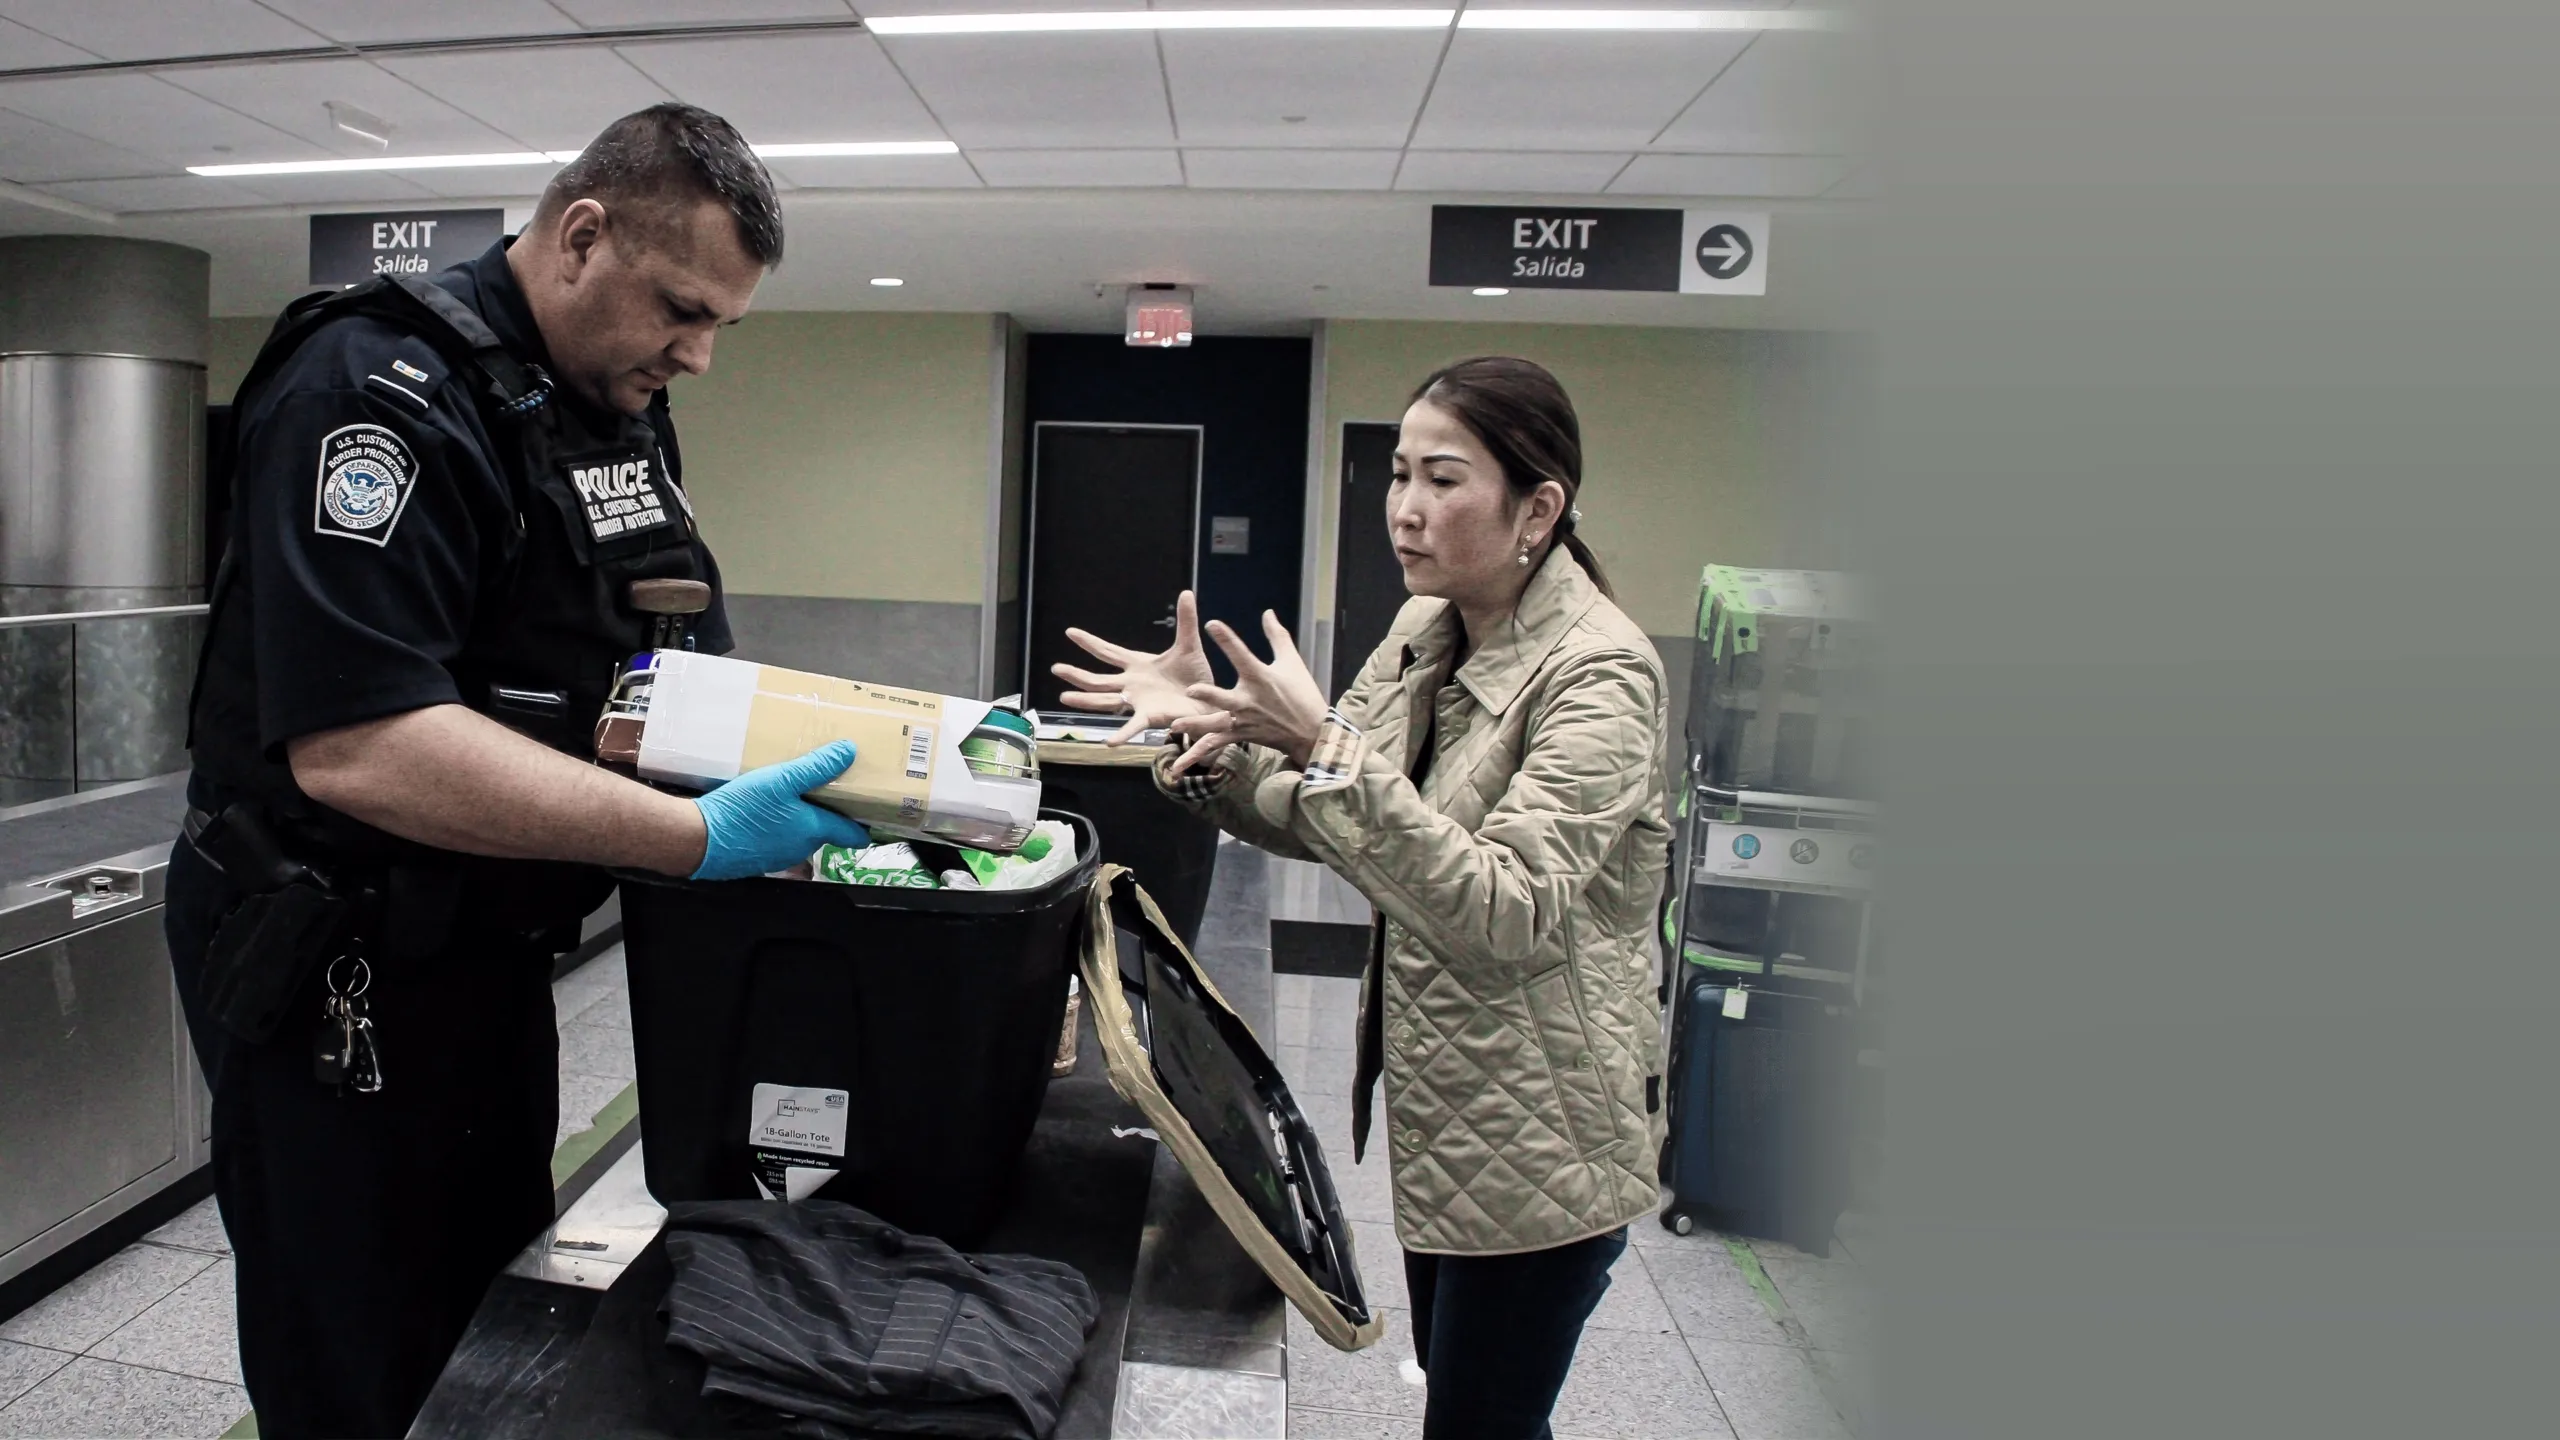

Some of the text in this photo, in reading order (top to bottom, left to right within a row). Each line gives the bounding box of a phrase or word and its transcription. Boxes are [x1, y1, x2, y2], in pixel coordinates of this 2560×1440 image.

[372, 220, 437, 249] EXIT
[1513, 217, 1598, 249] EXIT
[372, 253, 429, 274] Salida
[1512, 256, 1585, 278] Salida
[335, 436, 354, 449] U.S.
[356, 434, 400, 456] CUSTOMS
[327, 447, 408, 485] BORDER PROTECTION
[346, 461, 392, 486] DEPARTMENT
[387, 488, 395, 498] OF
[573, 459, 653, 502] POLICE
[327, 492, 391, 527] HOMELAND SECURITY
[587, 504, 605, 521] U.S.
[639, 493, 661, 508] AND
[593, 517, 624, 537] BORDER
[764, 1127, 807, 1140] 18-Gallon
[809, 1132, 831, 1143] Tote
[792, 1157, 815, 1165] recycled
